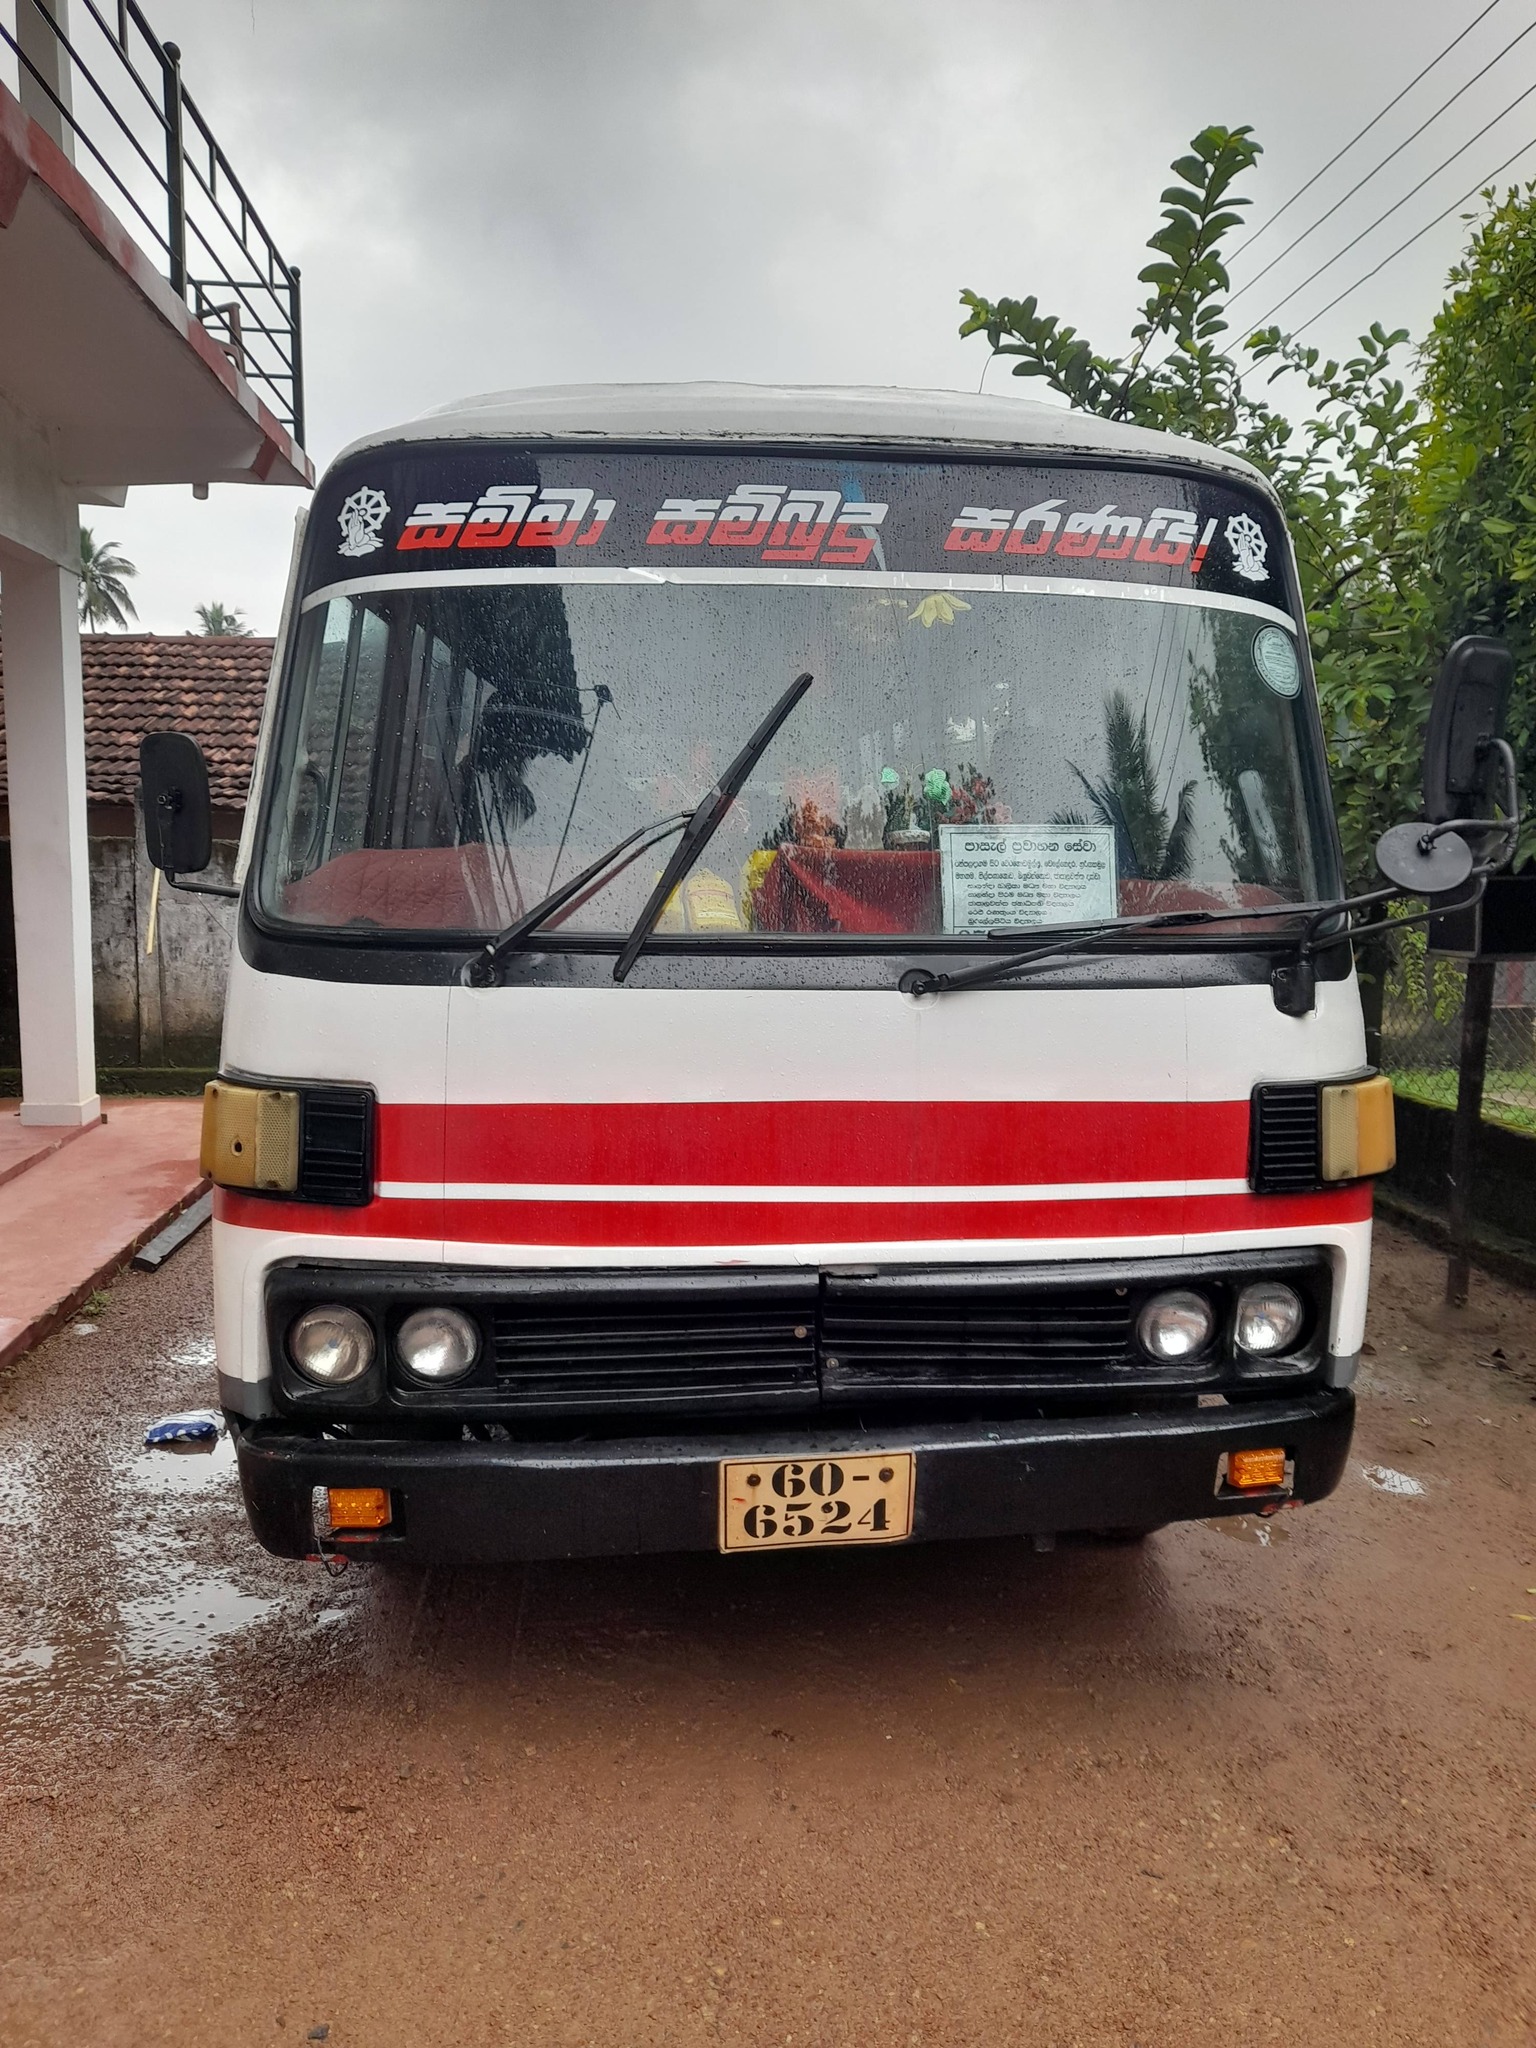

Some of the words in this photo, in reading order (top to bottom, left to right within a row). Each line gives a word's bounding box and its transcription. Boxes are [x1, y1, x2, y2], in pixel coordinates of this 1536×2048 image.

[396, 485, 616, 550] සම්මා
[647, 484, 889, 563] සම්බුදු
[964, 838, 1007, 853] පාසැල්
[1012, 840, 1059, 854] ප්‍රවාහන
[1064, 838, 1097, 852] සේවා
[771, 1462, 870, 1498] 60-
[743, 1498, 891, 1539] 6524
